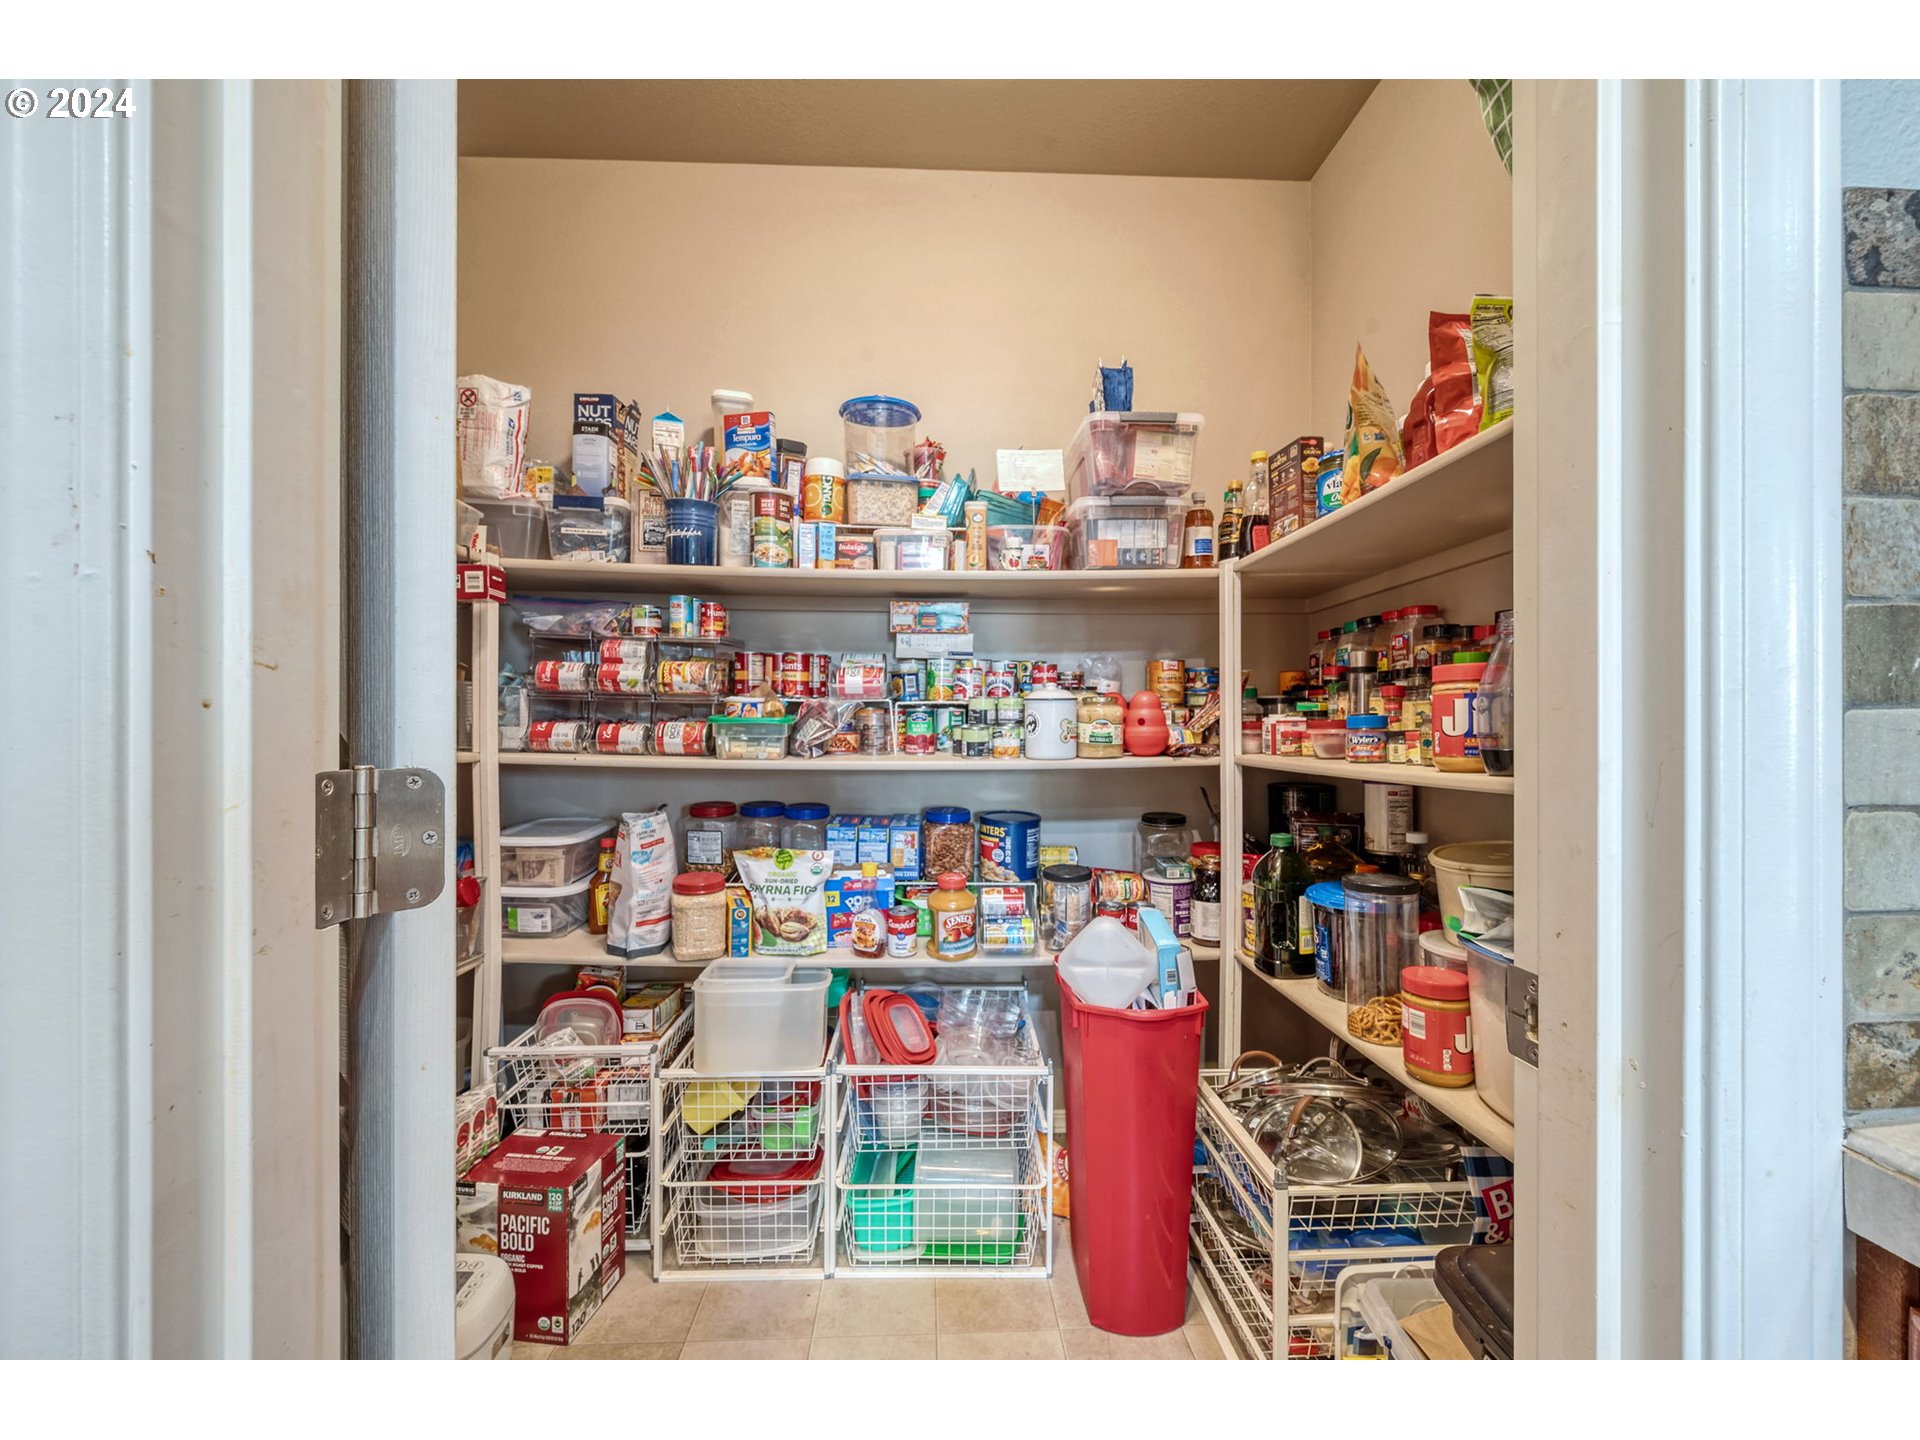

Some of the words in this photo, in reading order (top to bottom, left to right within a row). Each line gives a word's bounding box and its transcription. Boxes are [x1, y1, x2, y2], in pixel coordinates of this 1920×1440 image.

[577, 404, 612, 417] NUT
[827, 895, 836, 903] 12
[502, 1191, 543, 1201] KIRKLAND
[548, 1193, 562, 1201] 120
[500, 1213, 550, 1235] PACIFIC
[500, 1232, 534, 1252] BOLD
